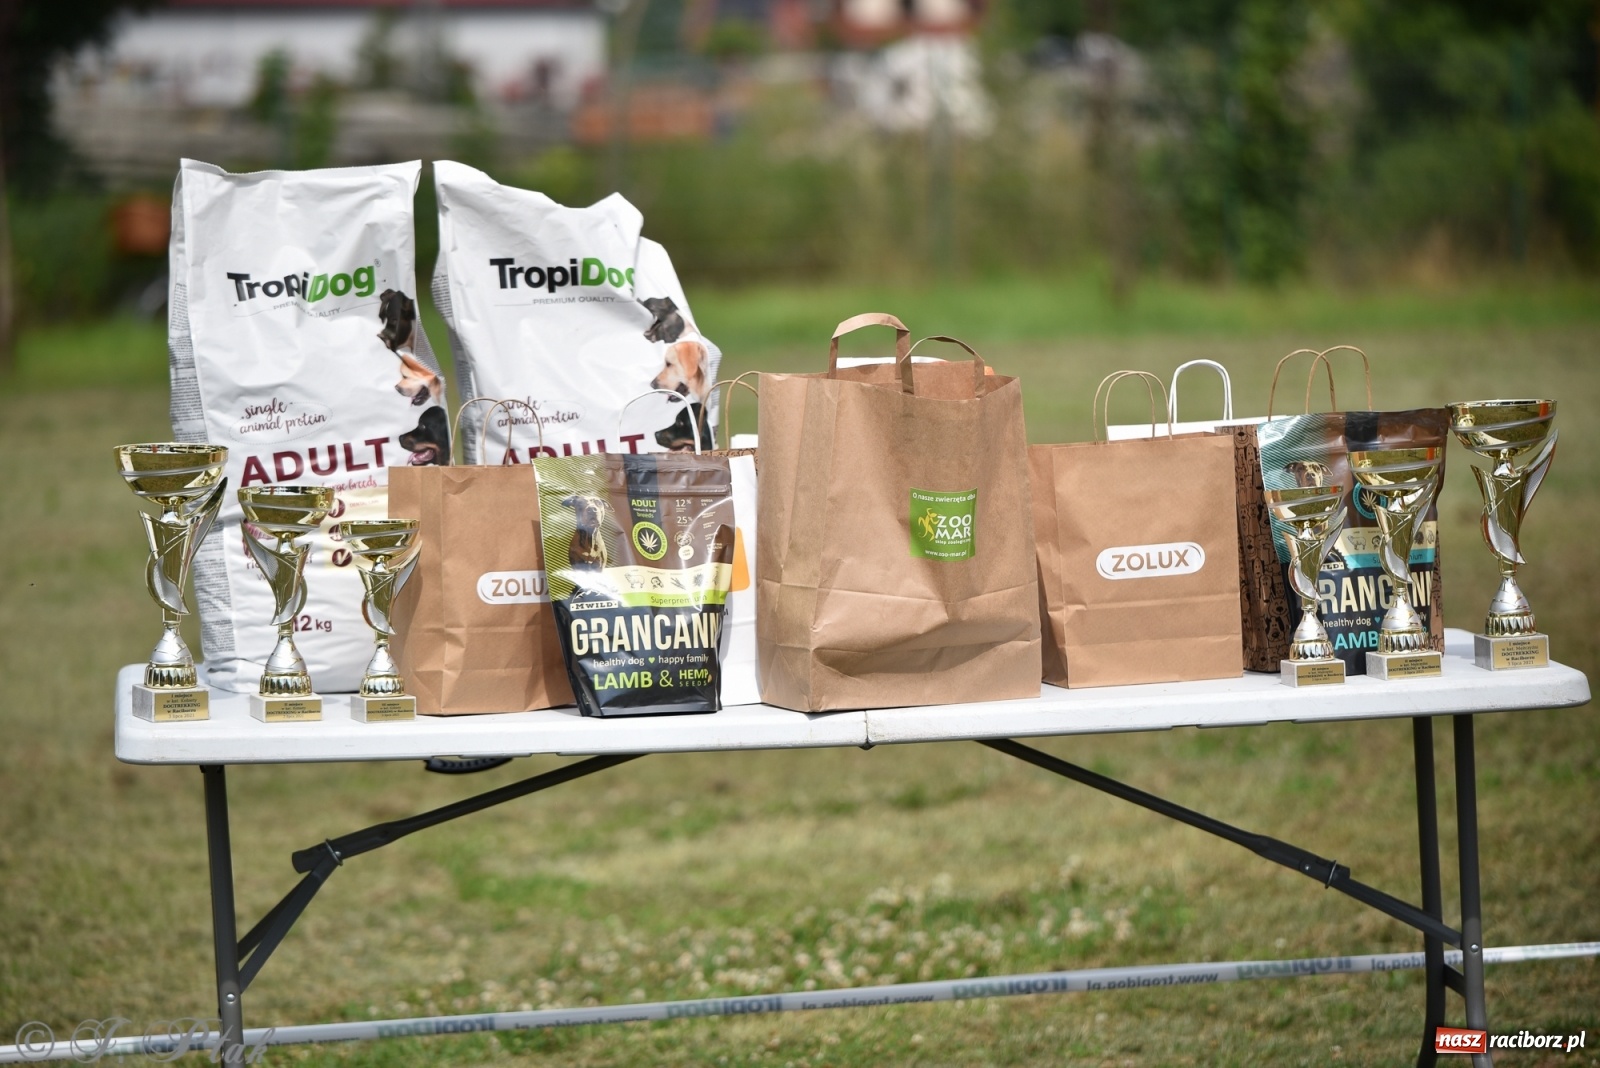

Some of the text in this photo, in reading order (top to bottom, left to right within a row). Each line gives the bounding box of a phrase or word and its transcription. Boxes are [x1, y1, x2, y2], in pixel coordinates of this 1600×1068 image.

[227, 265, 376, 303] TropiDog
[532, 297, 576, 305] PREMIUM
[244, 397, 288, 421] single
[239, 412, 328, 435] animal protein
[240, 436, 390, 487] ADULT
[632, 499, 656, 507] ADULT
[937, 514, 972, 528] ZOO
[935, 527, 971, 540] MAR
[1111, 549, 1190, 573] ZOLUX
[491, 578, 549, 597] ZOLU
[575, 601, 613, 610] MWILD
[293, 615, 332, 632] 12 kg
[1323, 618, 1354, 628] healthy
[1356, 616, 1372, 626] dog
[1334, 630, 1379, 650] AMB
[594, 654, 709, 668] healthy dog happy family
[594, 670, 674, 690] LAMB &
[679, 669, 709, 680] HEMP
